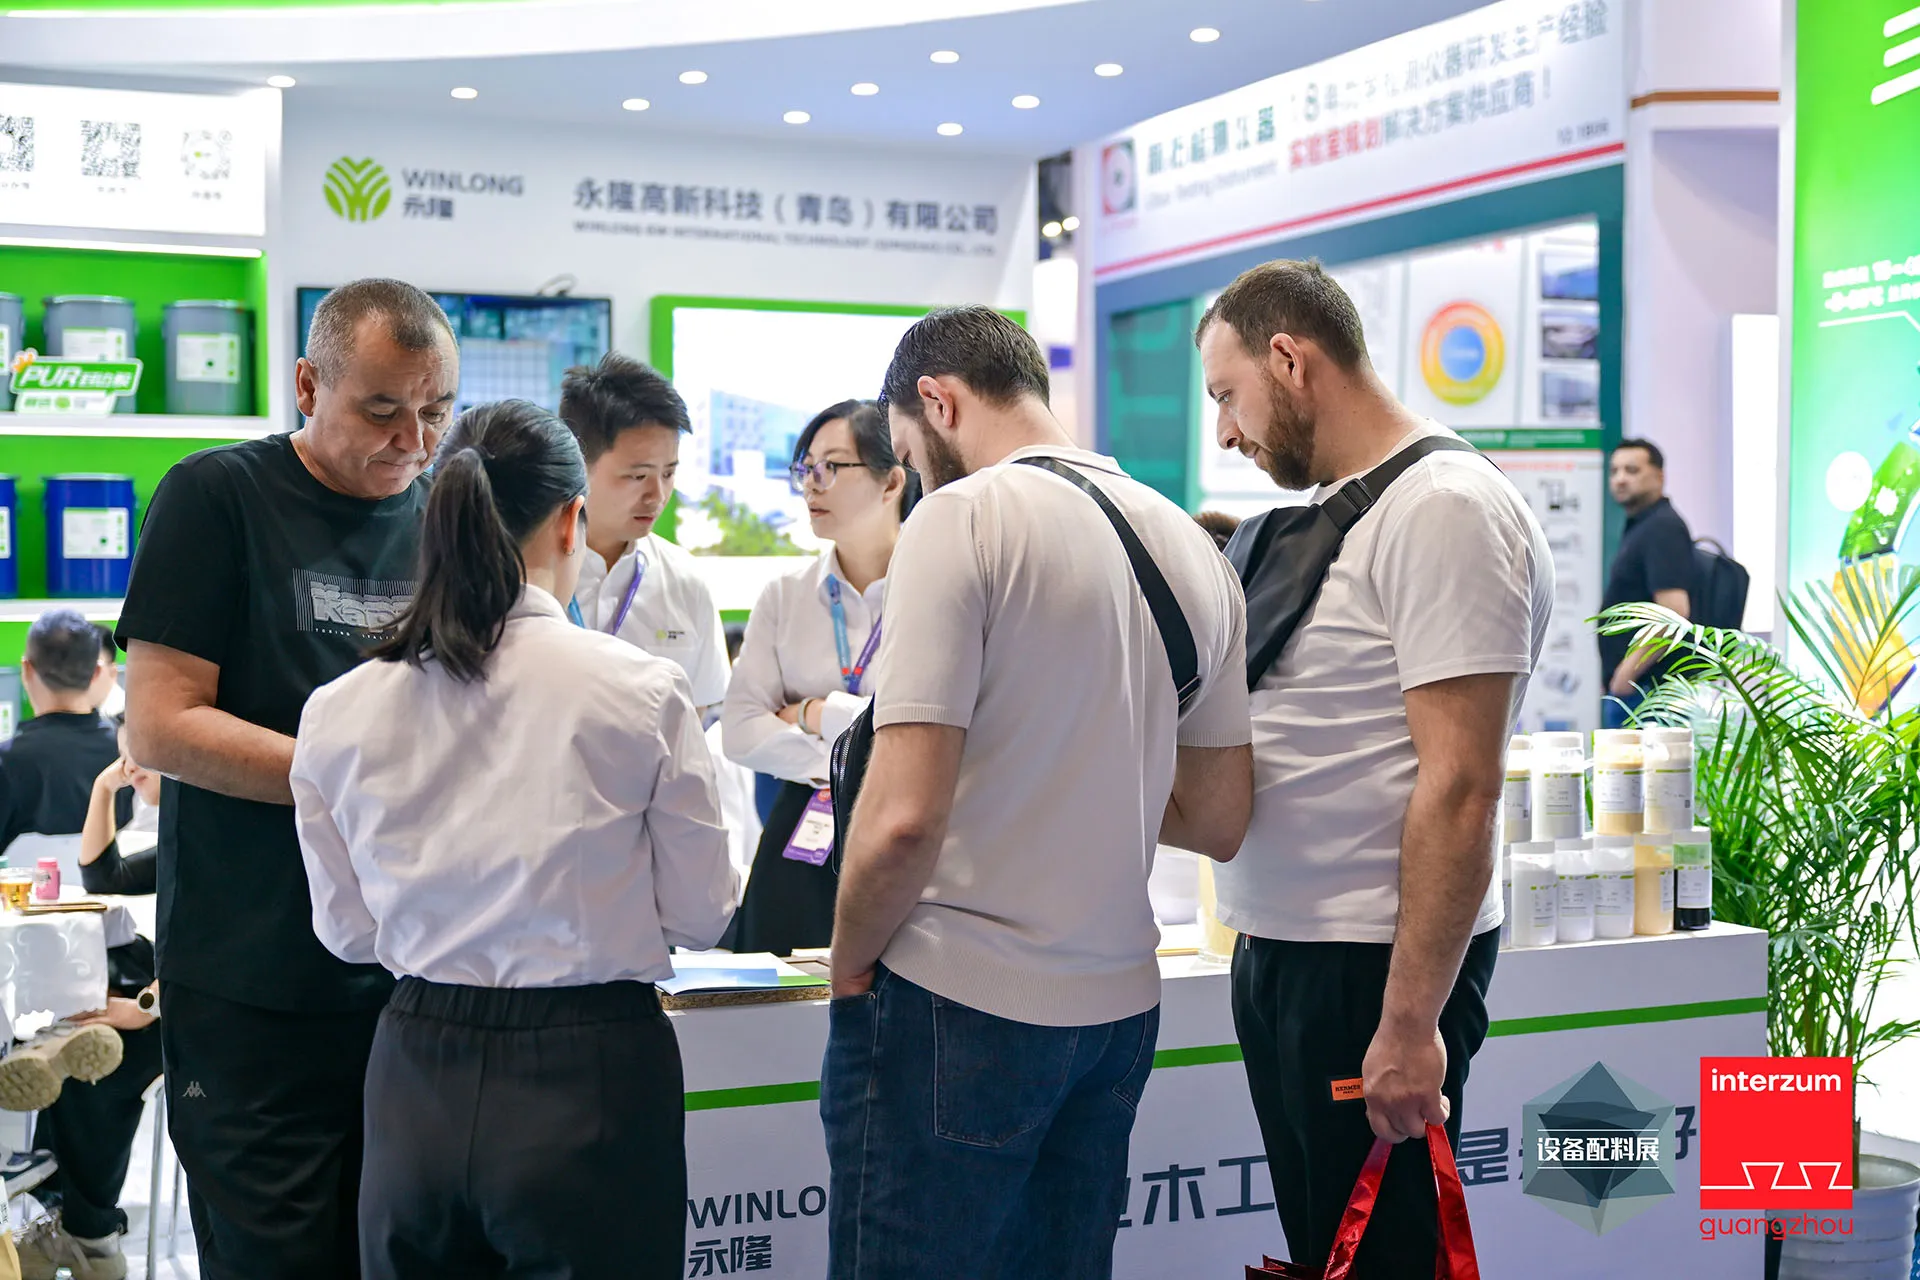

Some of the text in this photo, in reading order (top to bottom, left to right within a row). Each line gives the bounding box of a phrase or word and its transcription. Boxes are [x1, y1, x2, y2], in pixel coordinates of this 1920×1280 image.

[402, 168, 524, 196] WINLONG
[1456, 1127, 1509, 1187] 是
[687, 1186, 827, 1229] WINLO
[688, 1235, 772, 1278] 永隆
